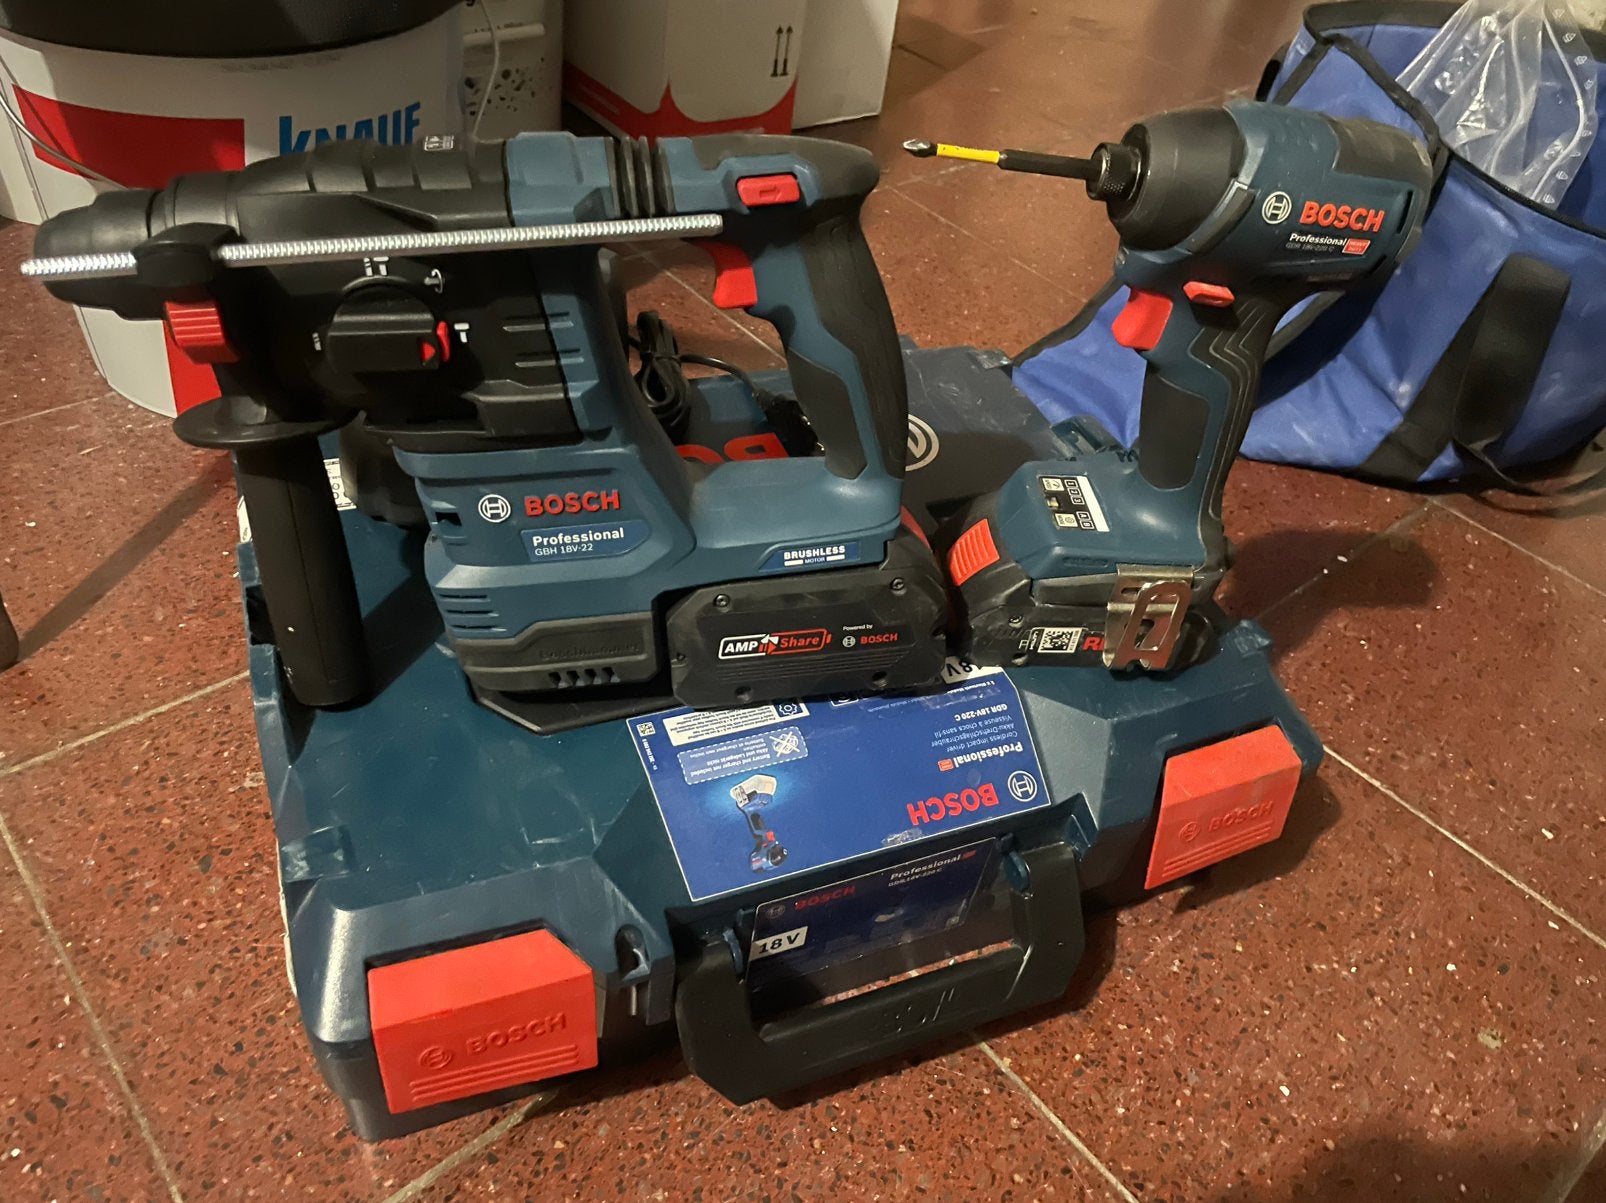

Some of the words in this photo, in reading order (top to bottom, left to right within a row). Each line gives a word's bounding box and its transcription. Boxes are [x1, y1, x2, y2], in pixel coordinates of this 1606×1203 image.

[1299, 200, 1385, 232] BOSCH
[1289, 233, 1347, 246] Professional
[524, 489, 621, 517] BOSCH
[532, 527, 625, 547] Professional
[534, 547, 558, 556] GBH
[560, 543, 594, 554] 18V-22
[783, 545, 846, 560] BRUSHLESS
[804, 556, 825, 564] MOTOR
[842, 624, 865, 632] Powered
[866, 623, 874, 631] by
[724, 641, 759, 654] AMP
[780, 636, 820, 649] Share
[860, 633, 899, 645] BOSCH
[946, 664, 961, 677] V
[990, 703, 1008, 713] GDR
[954, 714, 961, 722] C
[984, 715, 1012, 725] Visseuse
[934, 726, 958, 739] sans-fil
[958, 722, 978, 731] chocs
[931, 722, 1015, 747] Akku-Drehschlagschrauber
[989, 730, 1018, 740] Cordless
[946, 743, 966, 752] driver
[967, 737, 989, 748] impact
[953, 741, 1024, 767] Professional
[907, 783, 999, 826] BOSCH
[1208, 801, 1273, 832] BOSCH
[890, 854, 961, 880] Professional
[794, 885, 856, 910] BOSCH
[758, 936, 783, 954] 18
[786, 932, 800, 945] V
[466, 1012, 567, 1055] BOSCH
